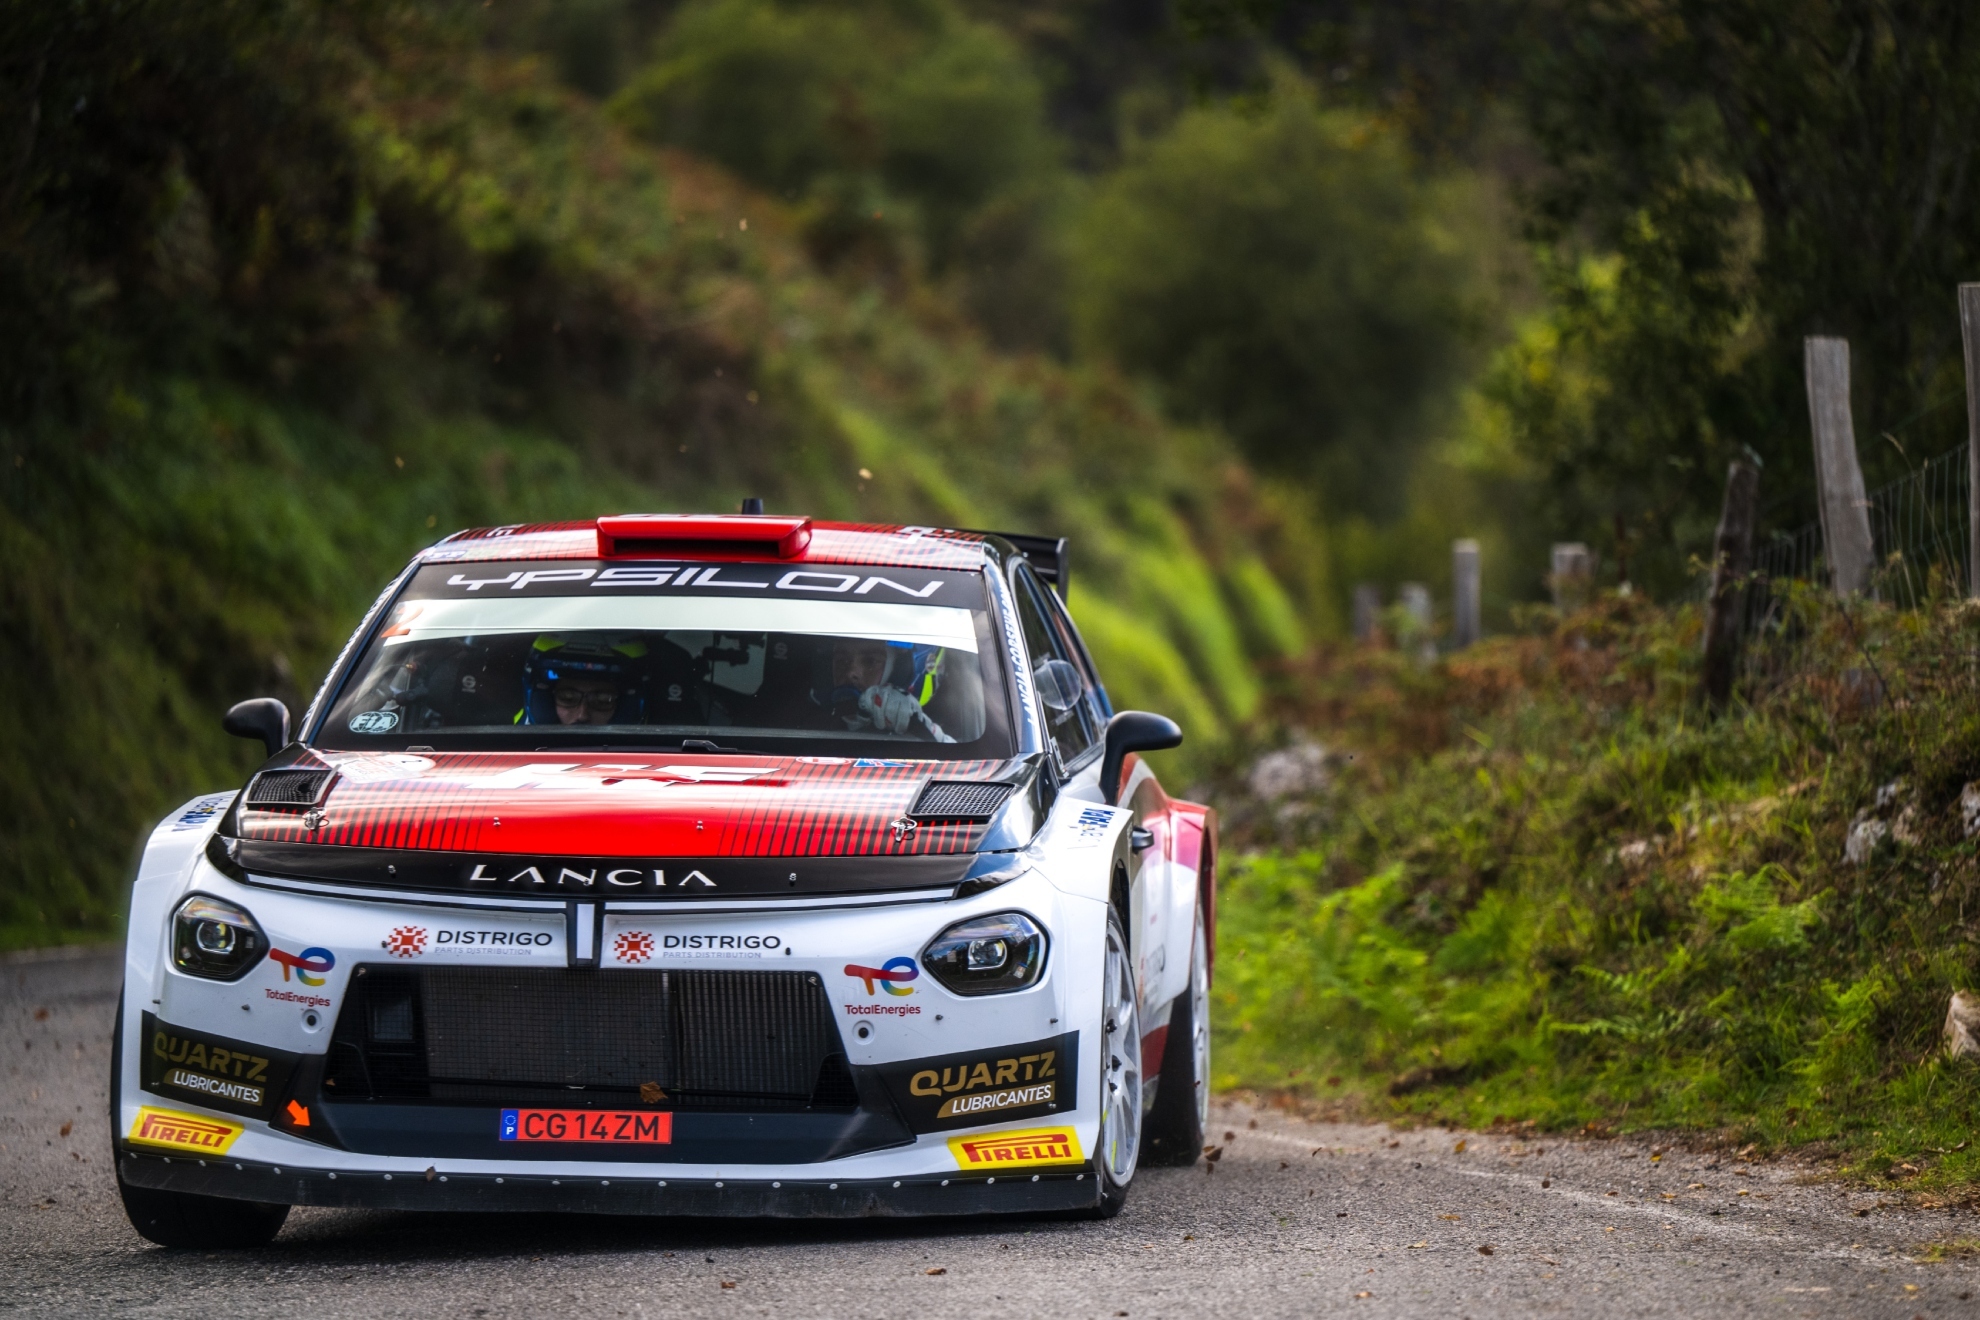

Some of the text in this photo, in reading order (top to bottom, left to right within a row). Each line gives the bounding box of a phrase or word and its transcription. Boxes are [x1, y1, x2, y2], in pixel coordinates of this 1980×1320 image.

[447, 567, 944, 597] YPSILON
[381, 606, 424, 638] 2
[351, 714, 394, 731] FIA
[470, 864, 717, 886] LANCIA
[436, 930, 552, 946] DISTRIGO
[664, 935, 781, 949] DISTRIGO
[466, 947, 532, 955] DISTRIBUTION
[695, 951, 761, 959] DISTRIBUTION
[265, 989, 331, 1006] TotalEnergies
[844, 1004, 921, 1016] TotalEnergies
[154, 1031, 269, 1082] QUARTZ
[910, 1051, 1056, 1096] QUARTZ
[173, 1071, 261, 1102] LUBRICANTES
[951, 1084, 1052, 1114] LUBRICANTES
[139, 1113, 233, 1147] PIRELLI
[506, 1127, 514, 1135] P
[960, 1133, 1072, 1163] PIRELLI
